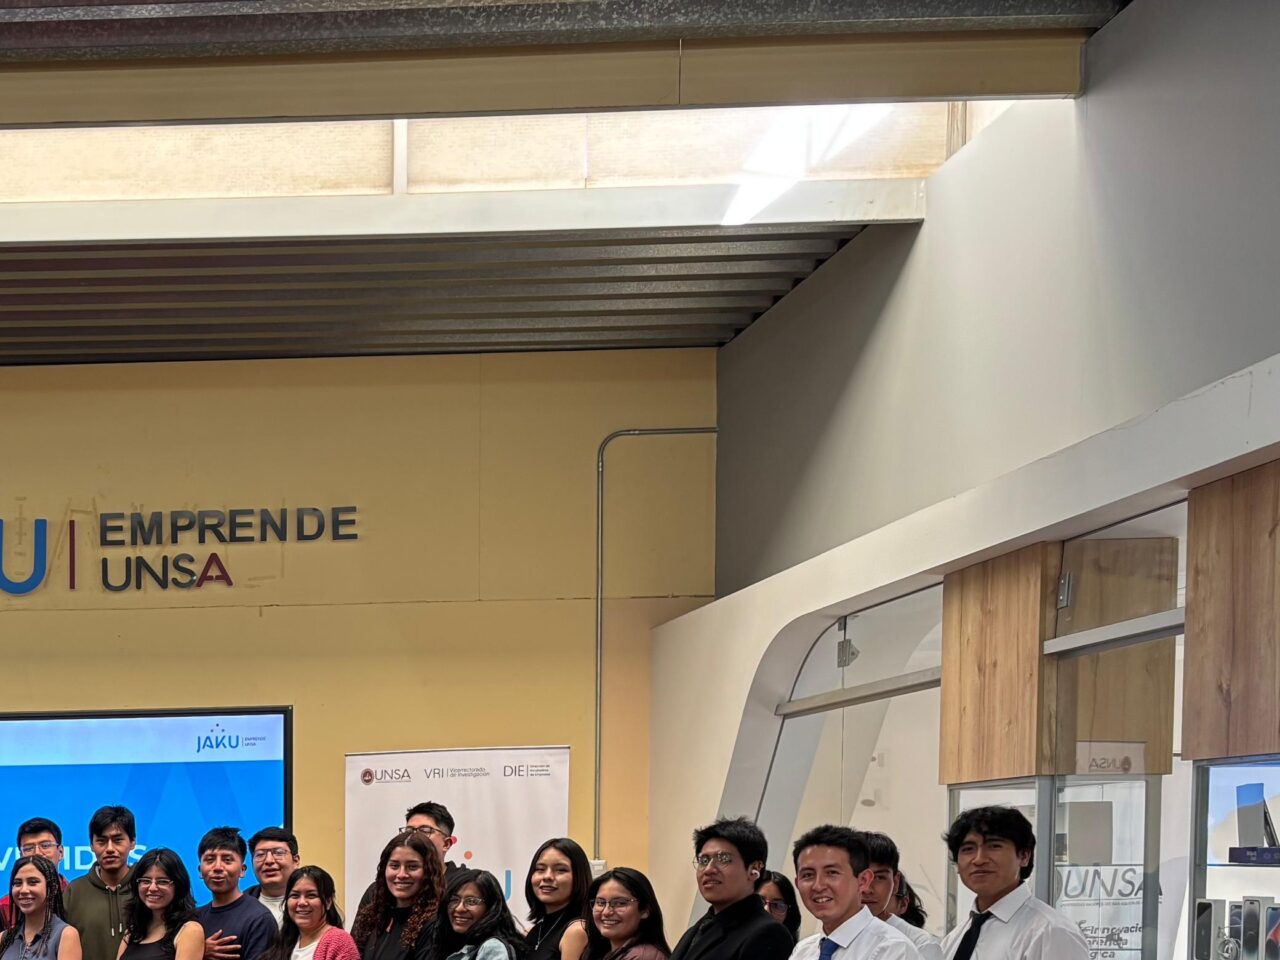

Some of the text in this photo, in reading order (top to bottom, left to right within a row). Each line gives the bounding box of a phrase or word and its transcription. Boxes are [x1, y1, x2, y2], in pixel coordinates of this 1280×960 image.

[99, 506, 358, 546] EMPRENDE
[101, 552, 234, 592] UNSA
[197, 735, 239, 753] JAKU
[375, 769, 411, 780] UNSA
[424, 768, 443, 779] VRI
[504, 765, 524, 776] DIE
